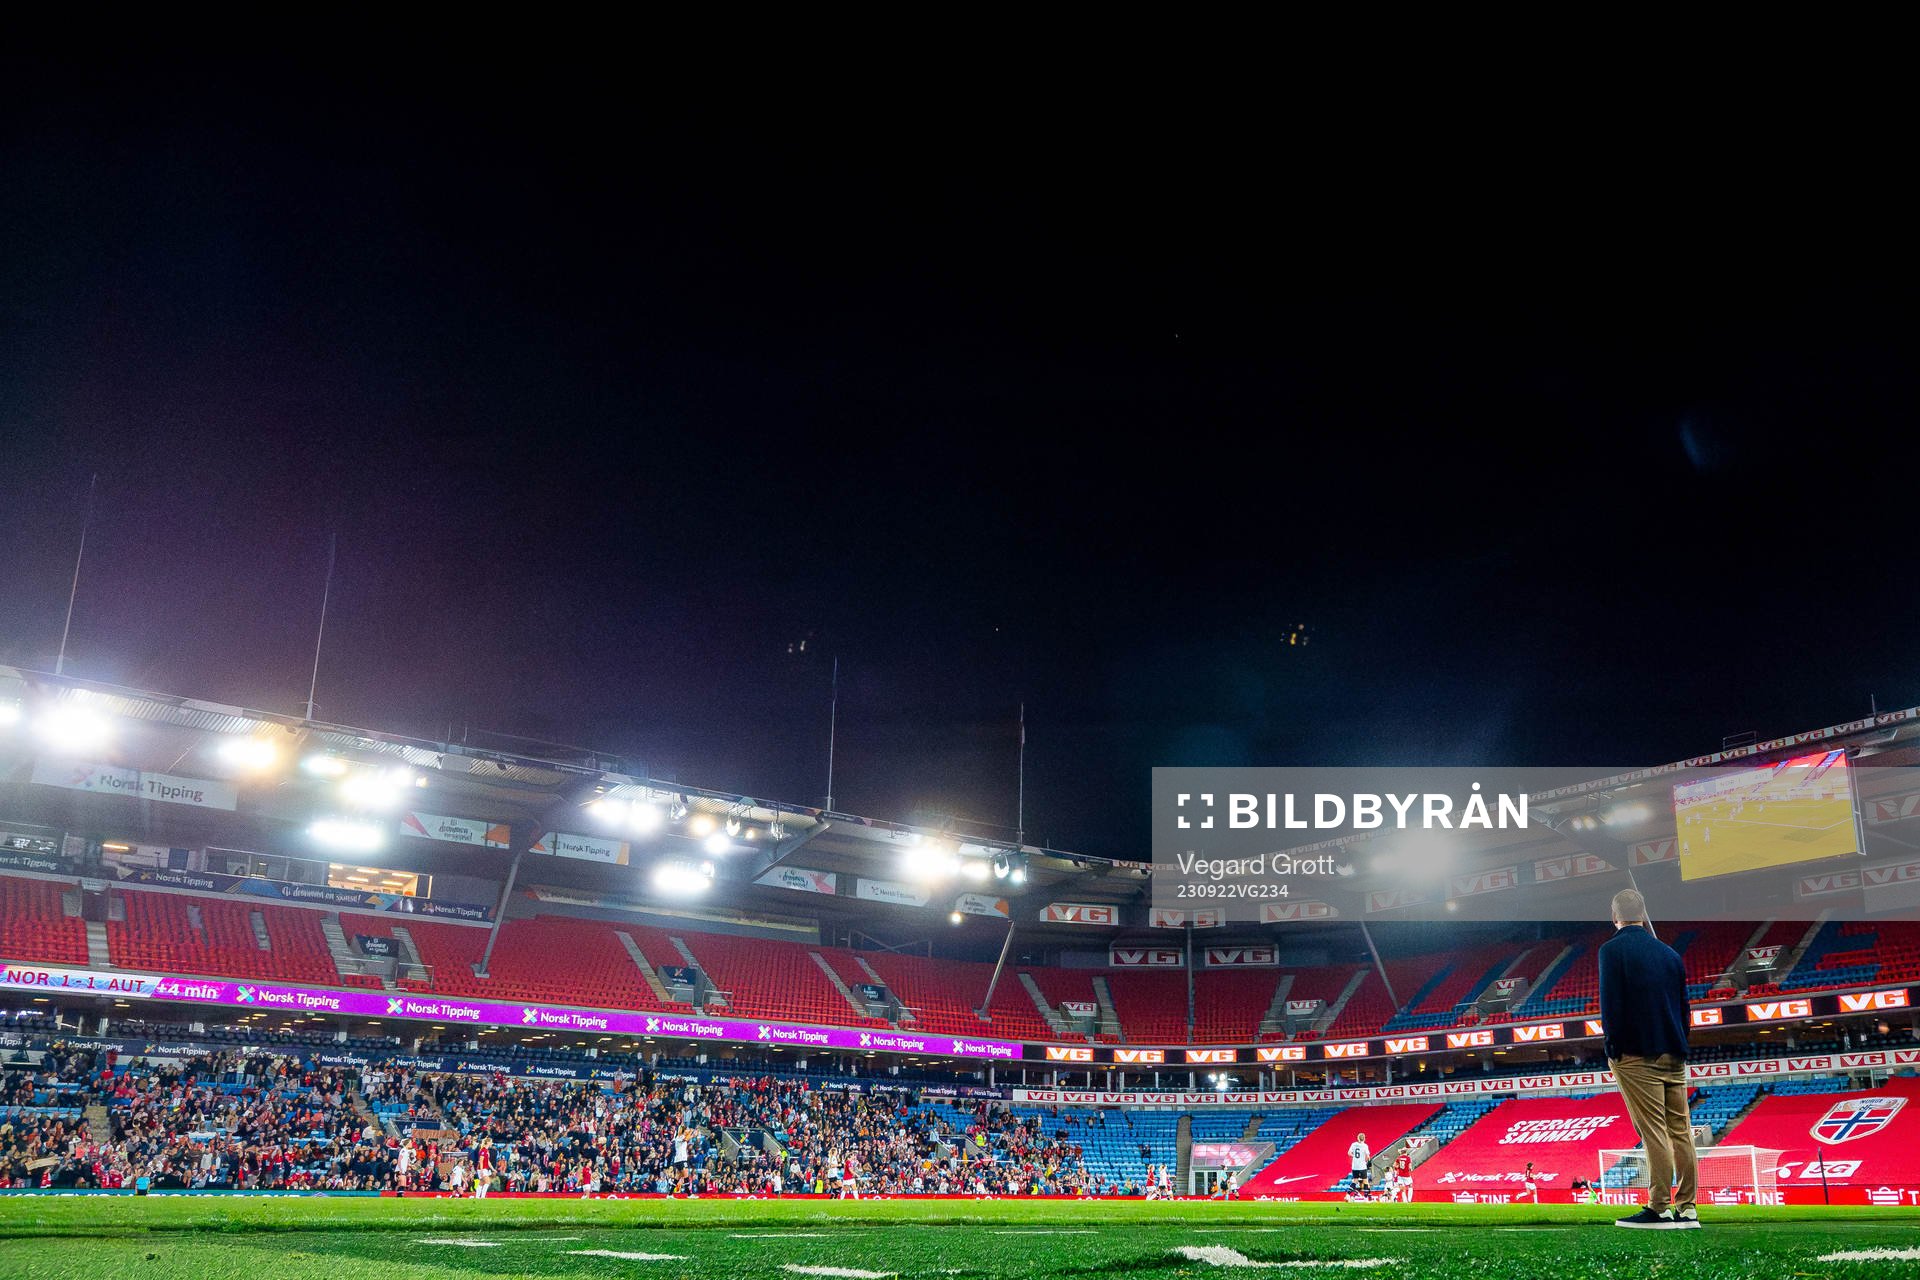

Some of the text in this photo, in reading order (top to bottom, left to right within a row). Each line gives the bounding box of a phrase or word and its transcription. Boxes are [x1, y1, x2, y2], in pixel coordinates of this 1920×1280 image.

[1797, 730, 1824, 742] VG
[1834, 721, 1864, 733] VG
[100, 774, 204, 802] Norsk Tipping
[584, 845, 610, 857] Tipping
[155, 872, 213, 888] Norsk Tipping
[1452, 871, 1509, 895] VG
[1804, 873, 1858, 891] VG
[435, 904, 482, 918] Norsk Tipping
[1052, 906, 1109, 922] VG
[1268, 903, 1328, 920] VG
[1114, 950, 1179, 965] VG
[1210, 949, 1273, 964] VG
[7, 970, 49, 985] NOR
[108, 978, 145, 993] AUT
[157, 983, 181, 996] +4
[184, 985, 217, 999] min
[259, 990, 340, 1009] Norsk Tipping
[1066, 1002, 1093, 1012] VG
[406, 1002, 480, 1019] Norsk Tipping
[541, 1012, 607, 1029] Norsk Tipping
[1047, 1048, 1093, 1061] VG
[1115, 1050, 1162, 1063] VG
[1187, 1050, 1235, 1063] VG
[1258, 1047, 1304, 1061] VG
[1325, 1043, 1366, 1058] VG
[1386, 1037, 1427, 1053] VG
[1447, 1031, 1493, 1048] VG
[1514, 1025, 1563, 1042] VG
[1748, 1000, 1809, 1020] VG
[1840, 990, 1905, 1012] VG
[663, 1021, 723, 1036] Norsk Tipping
[773, 1029, 828, 1043] Norsk Tipping
[0, 1038, 31, 1048] Tippig
[158, 1046, 180, 1054] Norsk
[874, 1036, 924, 1050] Norsk Tipping
[965, 1043, 1012, 1057] Norsk Tipping
[322, 1055, 368, 1065] Norsk Tipping
[416, 1060, 441, 1069] Tipping
[468, 1063, 487, 1071] Norsk
[537, 1067, 576, 1077] Norsk Tipping
[1028, 1092, 1057, 1100] VG
[1064, 1093, 1096, 1101] VG
[1104, 1094, 1136, 1102] VG
[1143, 1094, 1176, 1103] VG
[1184, 1094, 1217, 1103] VG
[1225, 1094, 1257, 1102] VG
[1265, 1093, 1296, 1101] VG
[1304, 1091, 1333, 1100] VG
[1341, 1089, 1369, 1099] VG
[1376, 1087, 1403, 1097] VG
[1410, 1085, 1438, 1095] VG
[1445, 1083, 1474, 1093] VG
[1482, 1080, 1512, 1090] VG
[1520, 1078, 1552, 1088] VG
[1560, 1075, 1593, 1085] VG
[1691, 1066, 1729, 1077] VG
[1738, 1062, 1779, 1073] VG
[1789, 1058, 1830, 1069] VG
[1841, 1054, 1885, 1066] VG
[1508, 1115, 1620, 1132] STERKERE
[1499, 1128, 1597, 1145] SAMMEN
[1354, 1148, 1361, 1159] 6
[1809, 1163, 1853, 1174] 5G
[1461, 1172, 1504, 1182] Norsk
[1604, 1193, 1638, 1205] TINE
